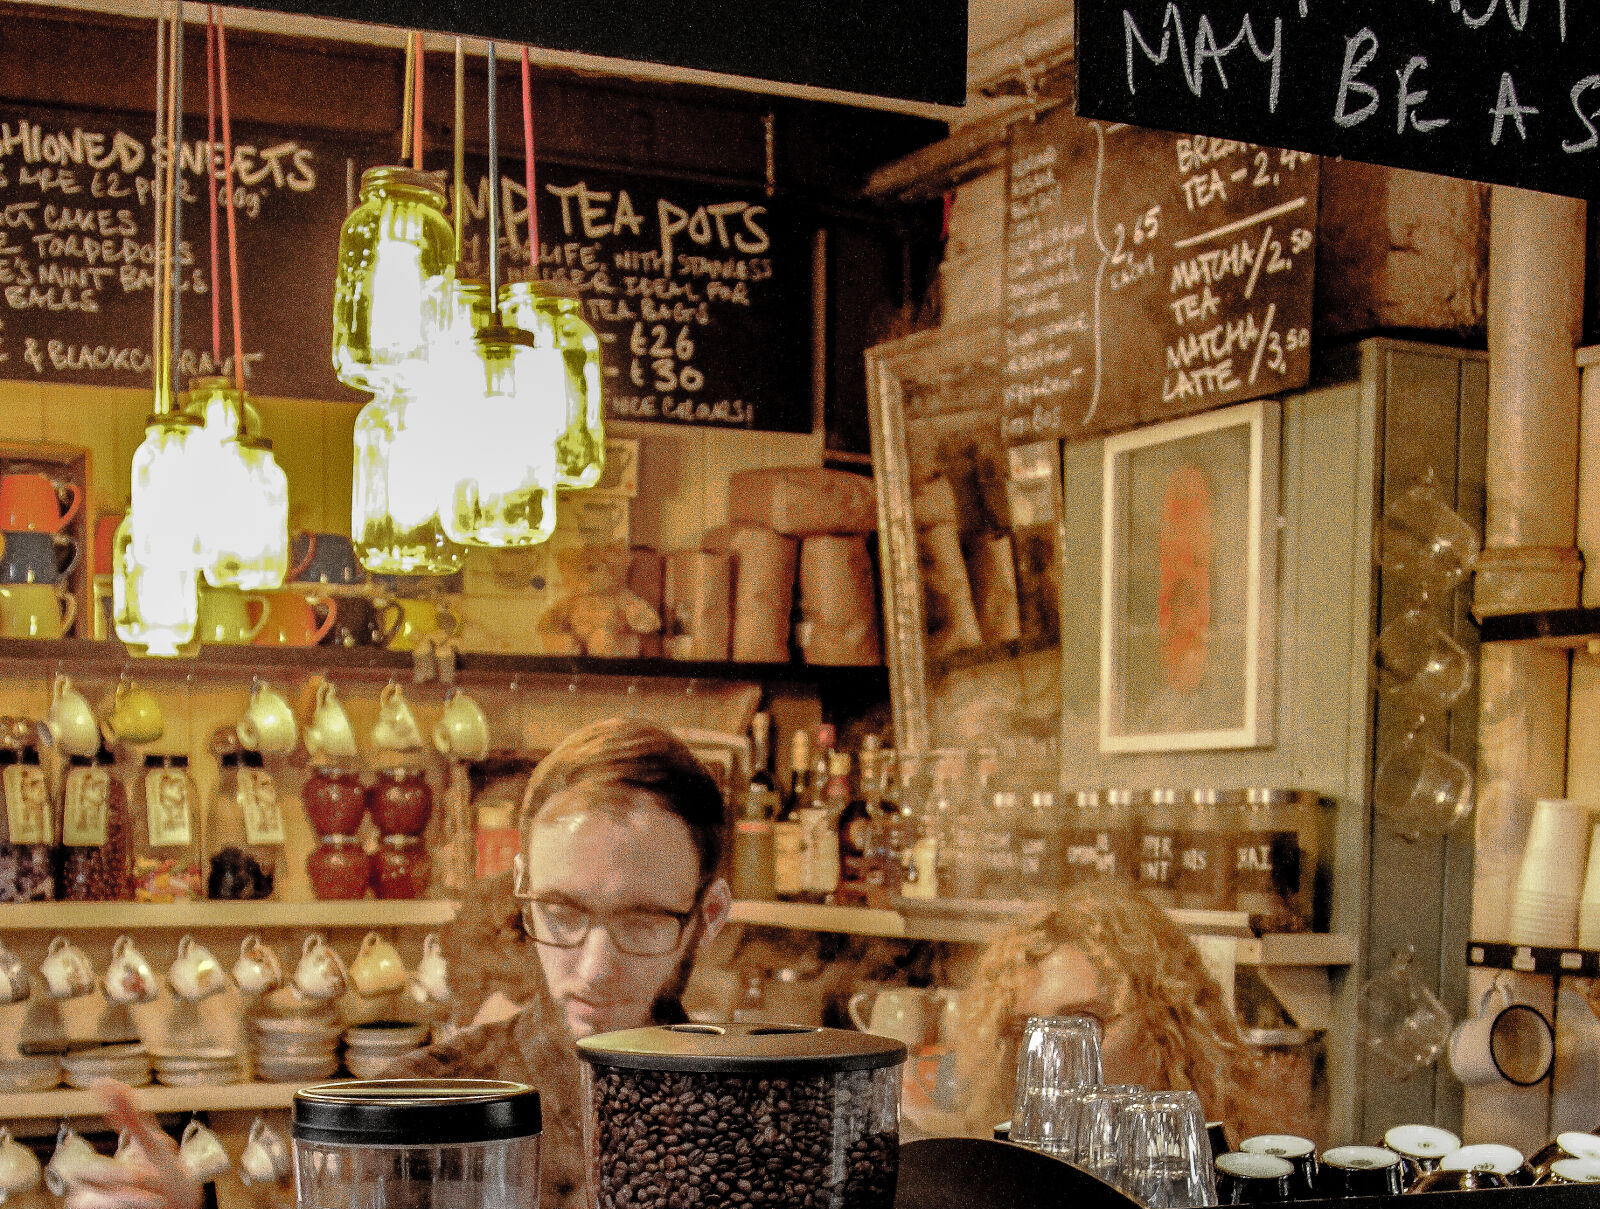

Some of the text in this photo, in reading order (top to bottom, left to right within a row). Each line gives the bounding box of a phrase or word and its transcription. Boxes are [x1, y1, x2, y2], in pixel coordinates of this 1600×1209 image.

[1122, 2, 1282, 113] MAY
[1334, 27, 1450, 135] BE
[1487, 72, 1540, 146] A
[0, 119, 145, 174] HIONED
[1181, 168, 1228, 212] TEA
[0, 201, 138, 236] CT CAKES
[545, 181, 645, 239] TEA
[657, 199, 771, 278] POTS
[39, 262, 116, 290] MINT
[1169, 286, 1221, 326] TEA
[1162, 358, 1242, 402] LATTE
